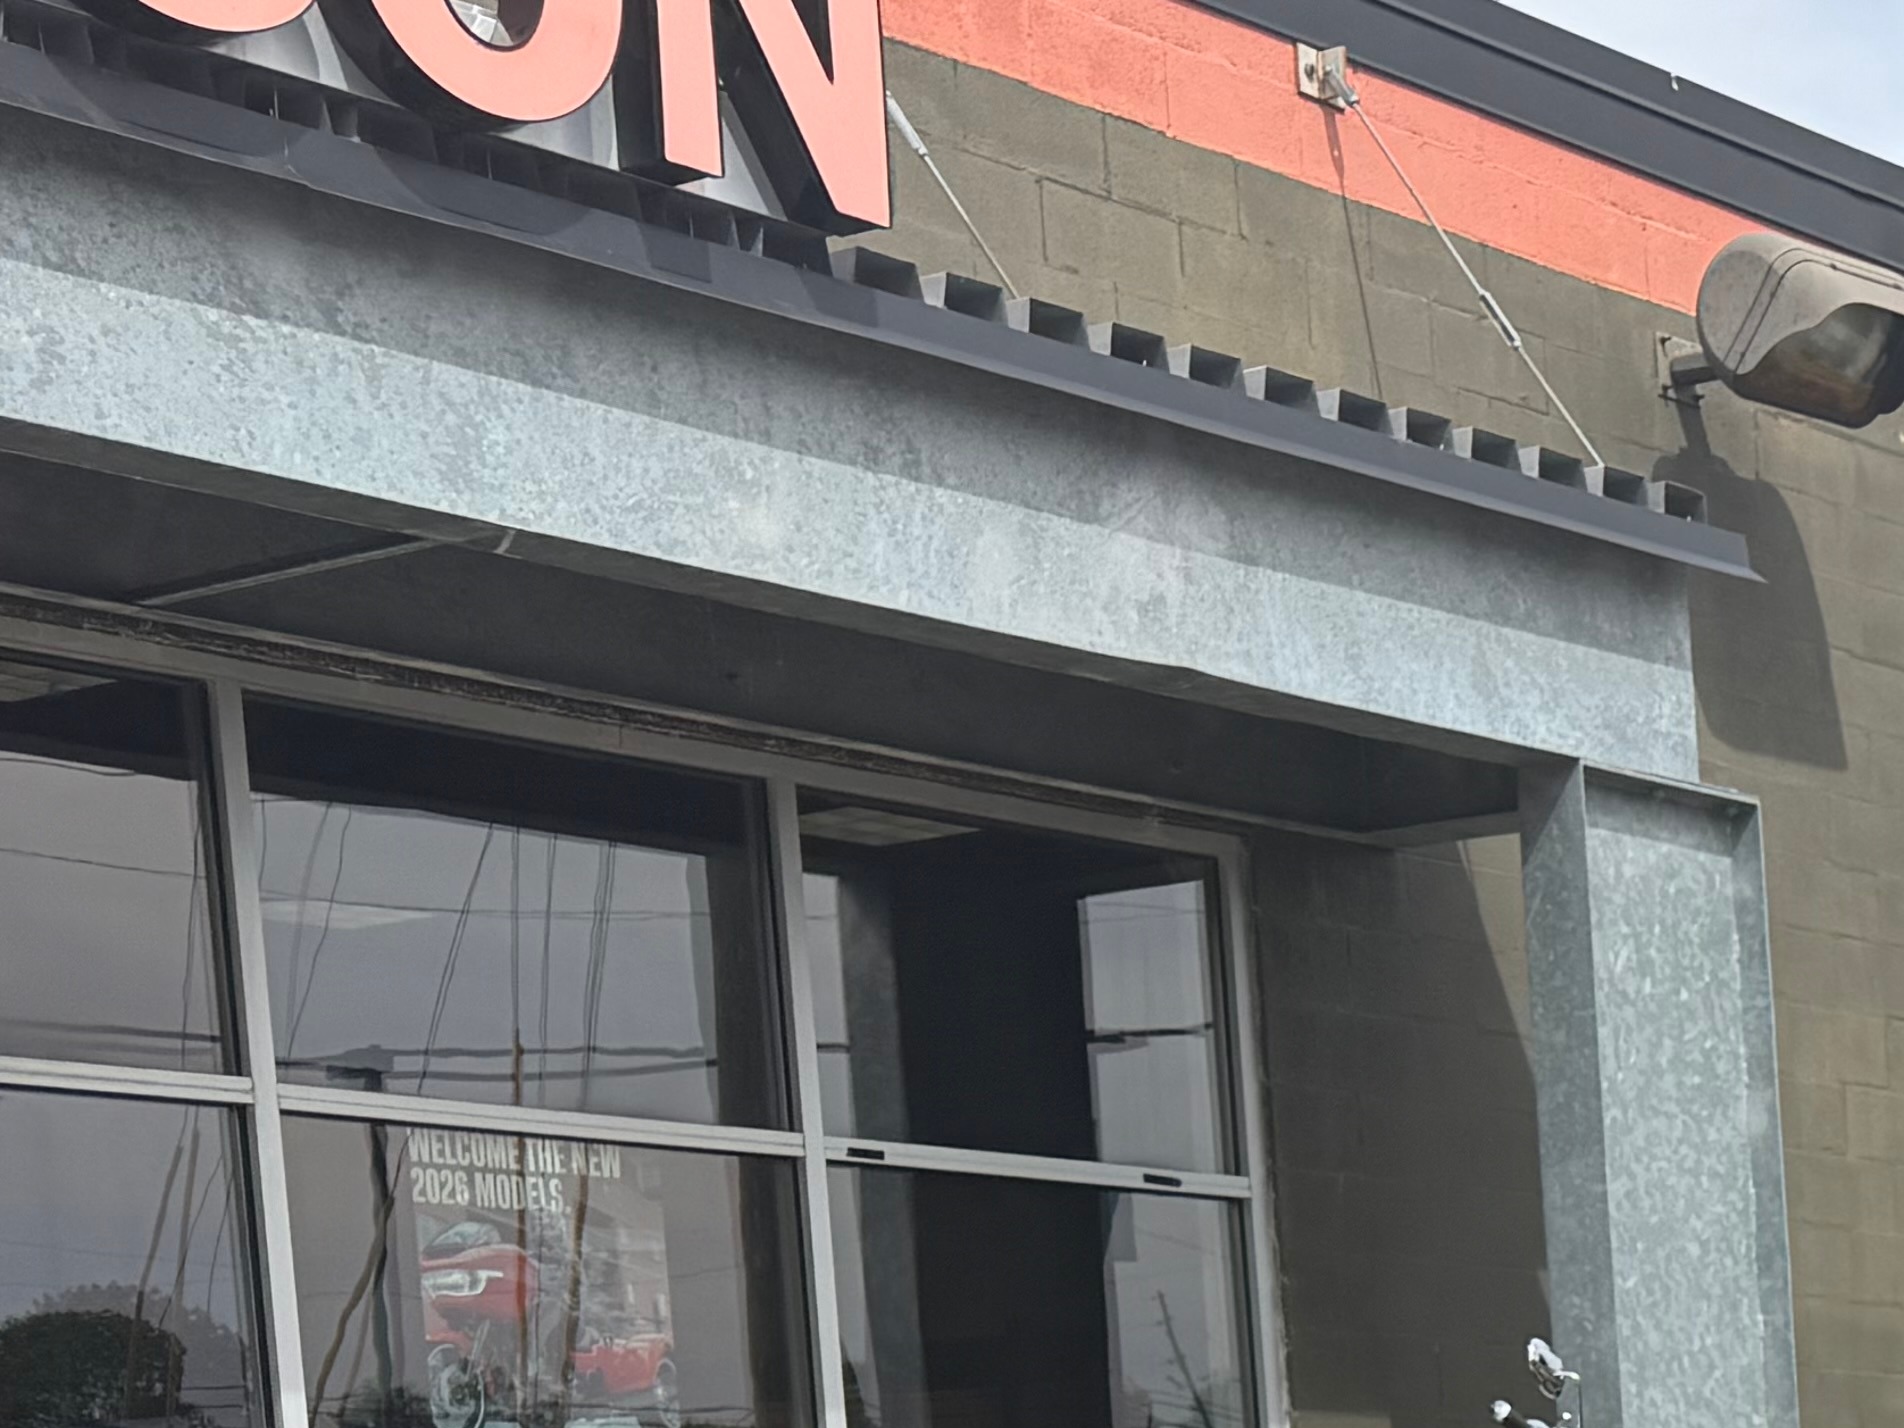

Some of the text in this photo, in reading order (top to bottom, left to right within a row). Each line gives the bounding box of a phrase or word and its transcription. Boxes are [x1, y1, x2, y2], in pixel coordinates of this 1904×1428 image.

[406, 1127, 621, 1178] WELCOME THE NEW
[410, 1167, 572, 1215] 2026 MODELS.
